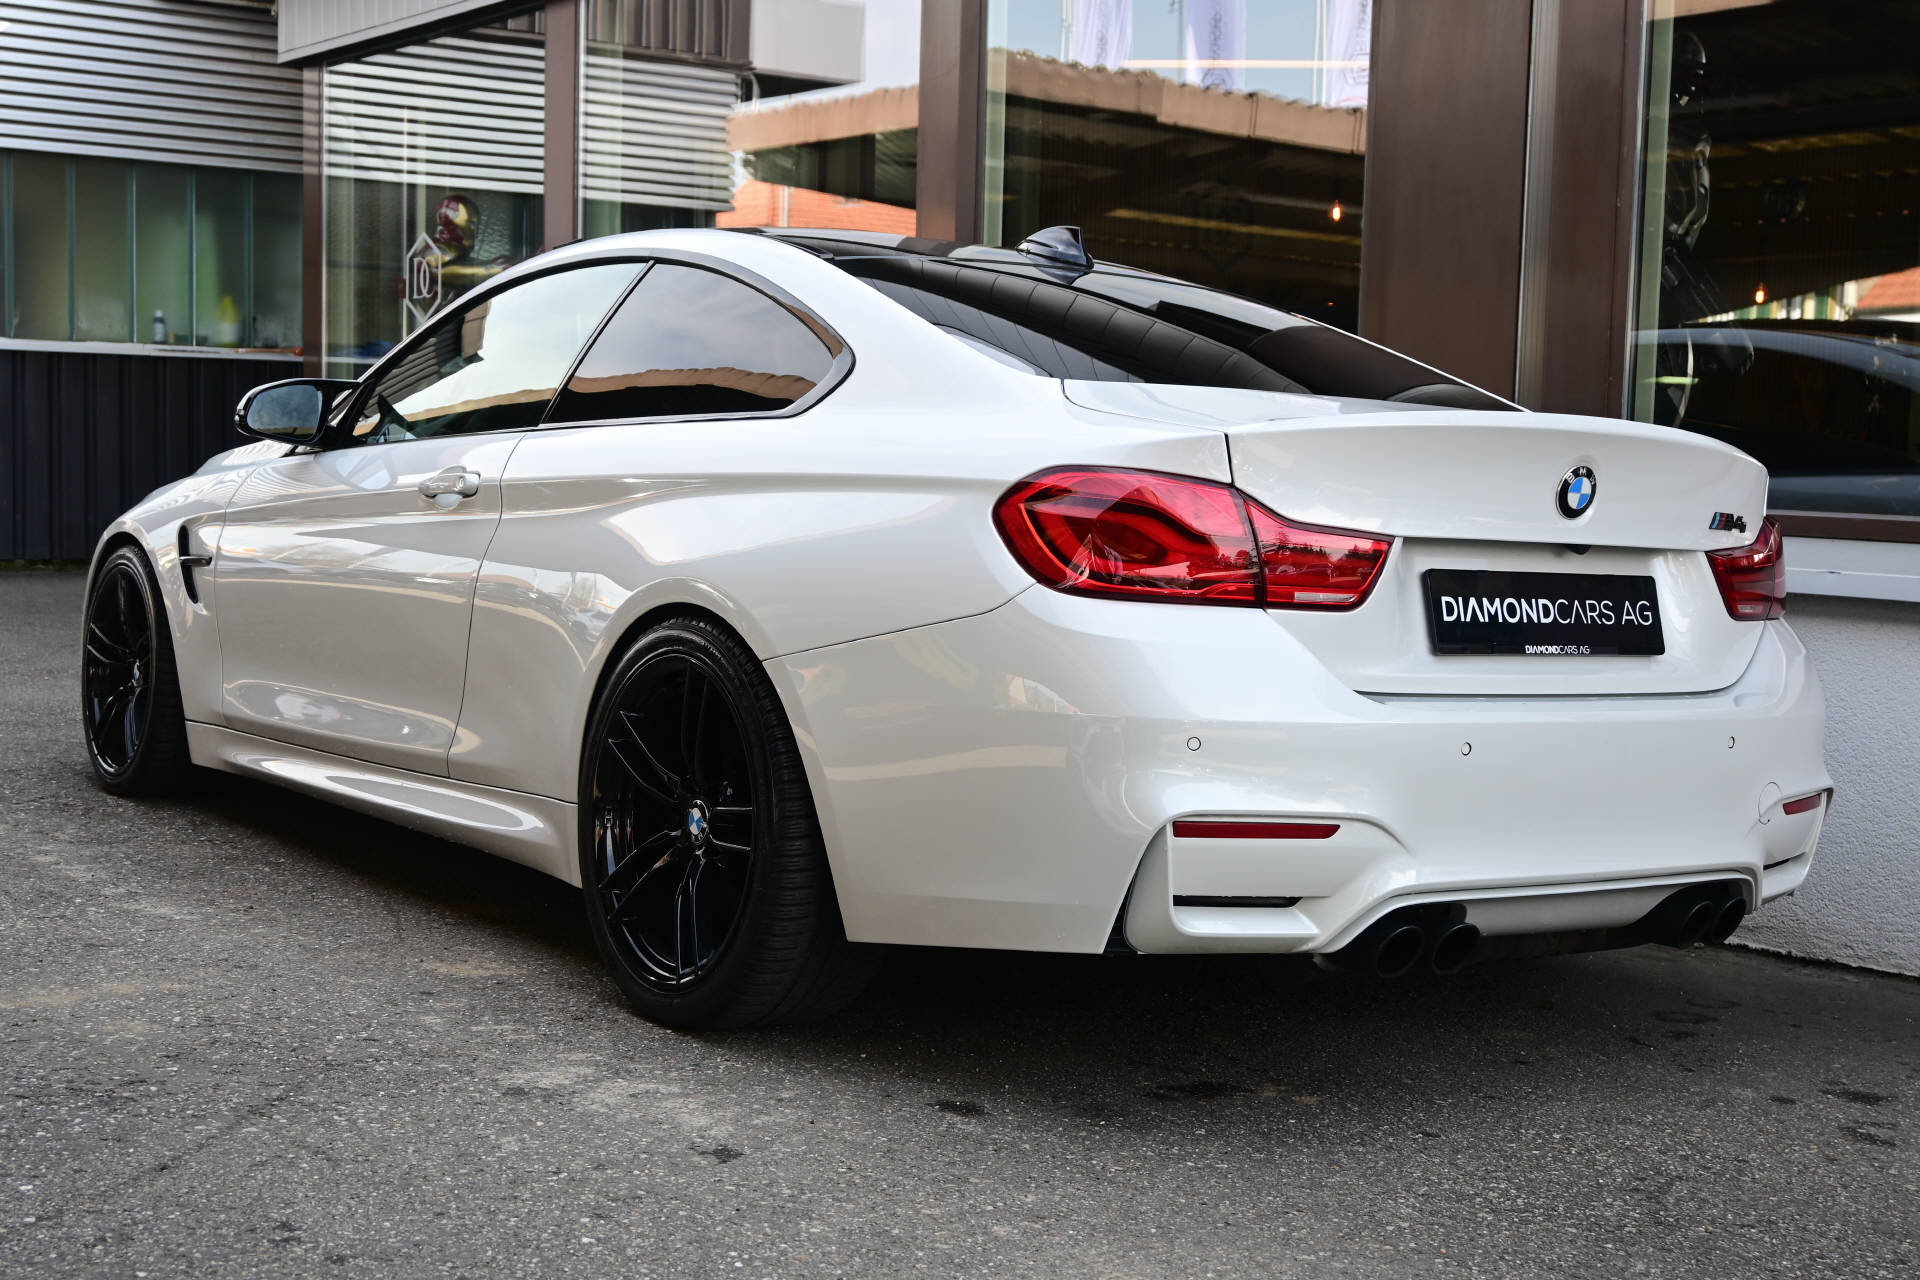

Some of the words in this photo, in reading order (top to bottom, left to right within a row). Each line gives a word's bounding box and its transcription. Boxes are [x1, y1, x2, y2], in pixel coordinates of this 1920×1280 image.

[1440, 596, 1615, 625] DIAMONDCARS
[1621, 600, 1653, 625] AG
[1525, 645, 1578, 654] DIAMONDCARS
[1579, 645, 1590, 654] AG
